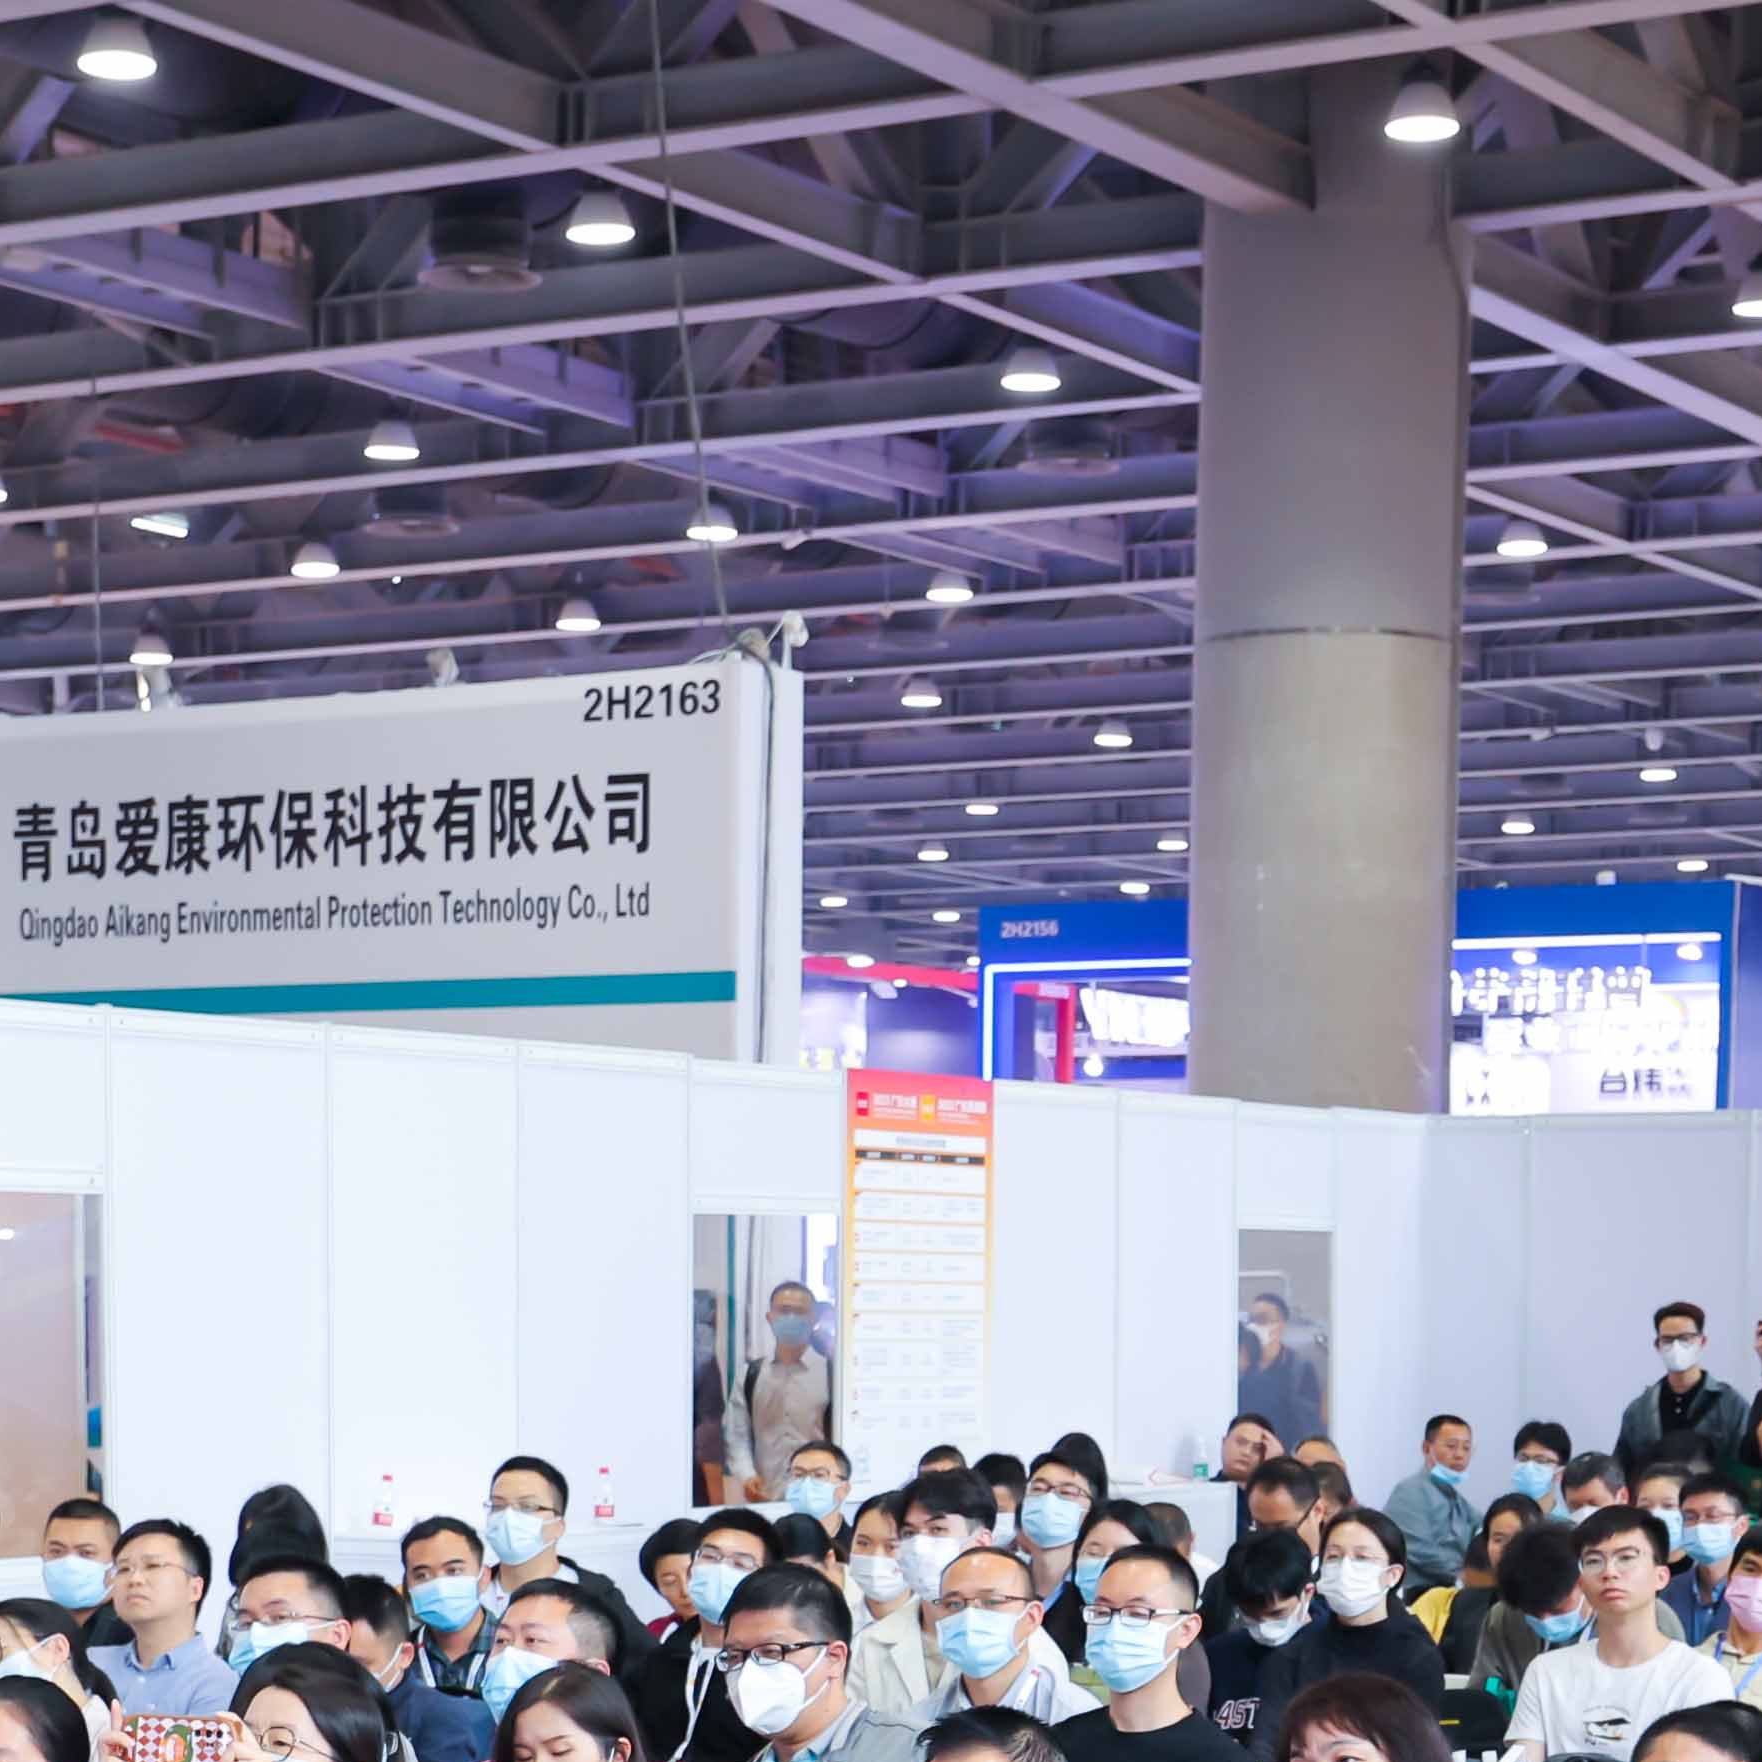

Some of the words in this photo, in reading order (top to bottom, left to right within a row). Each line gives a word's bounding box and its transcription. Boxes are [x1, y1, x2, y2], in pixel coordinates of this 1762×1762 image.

[583, 679, 721, 722] 2H2163
[13, 772, 652, 884] 青岛爱康环保科技有限公司
[19, 904, 99, 948] Qingdao
[105, 901, 171, 944] Aikang
[177, 896, 321, 936] Environmental
[328, 892, 434, 930] Protection
[440, 886, 560, 930] Technology
[568, 886, 609, 924] Co.,
[616, 882, 651, 918] Ltd
